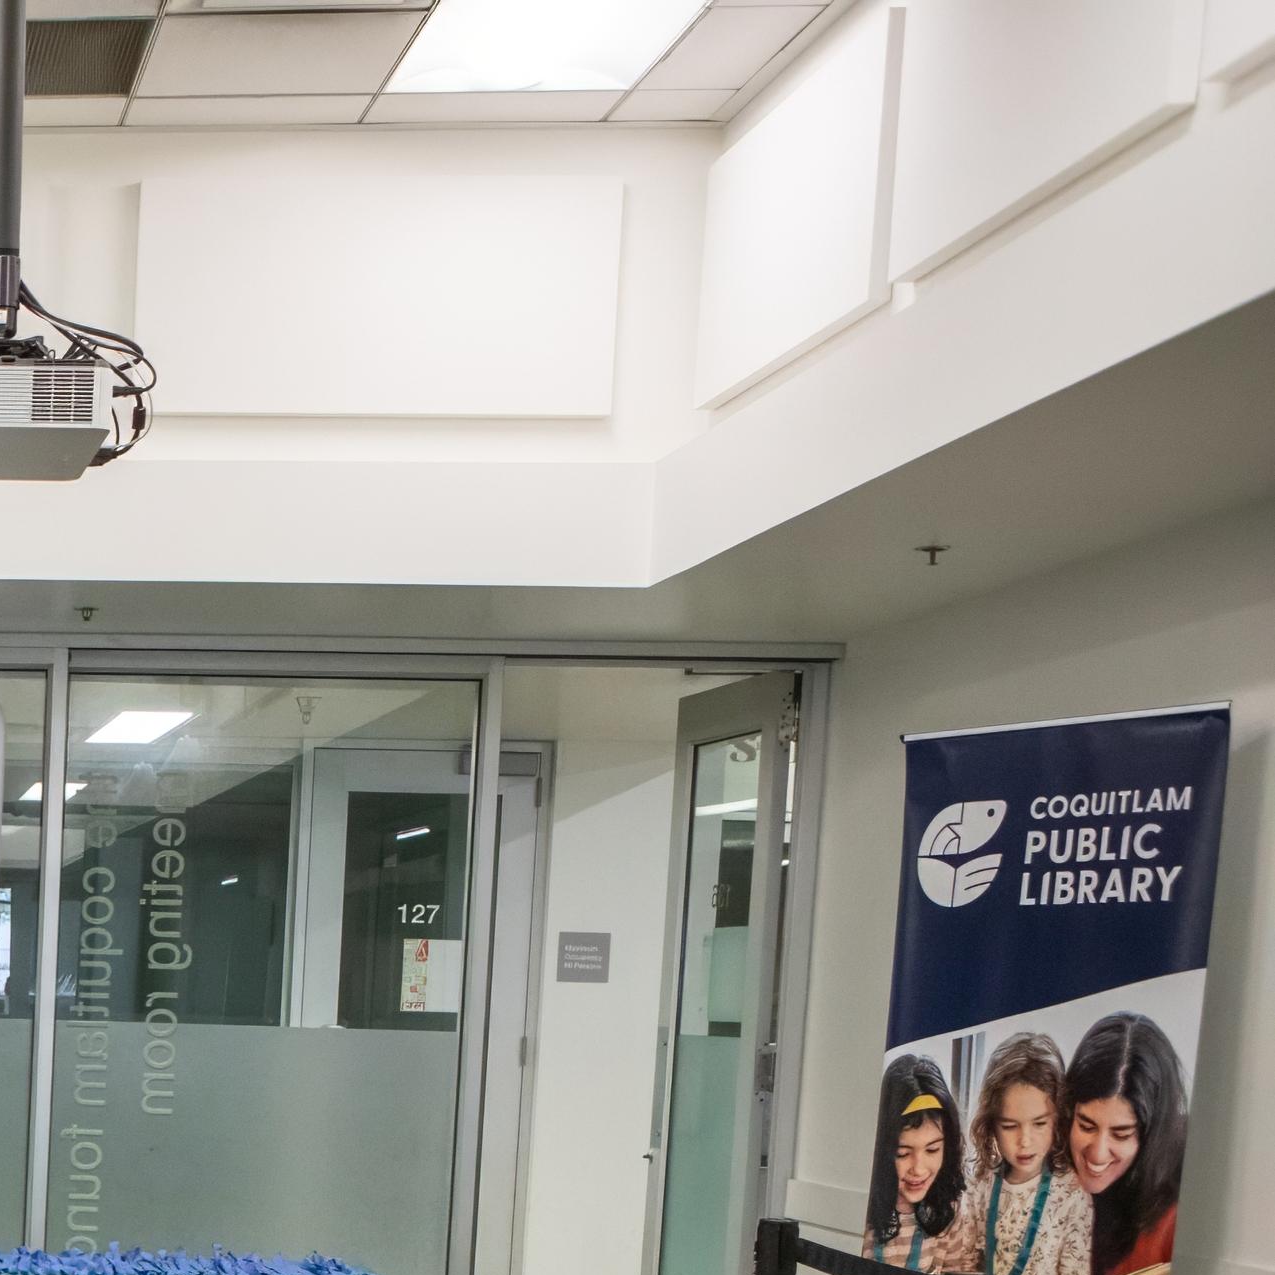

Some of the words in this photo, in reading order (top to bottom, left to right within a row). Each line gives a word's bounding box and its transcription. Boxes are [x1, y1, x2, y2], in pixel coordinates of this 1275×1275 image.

[1030, 786, 1192, 820] COQUITLAM
[1024, 823, 1162, 864] PUBLIC
[1019, 865, 1182, 906] LIBRARY
[397, 903, 441, 925] 127
